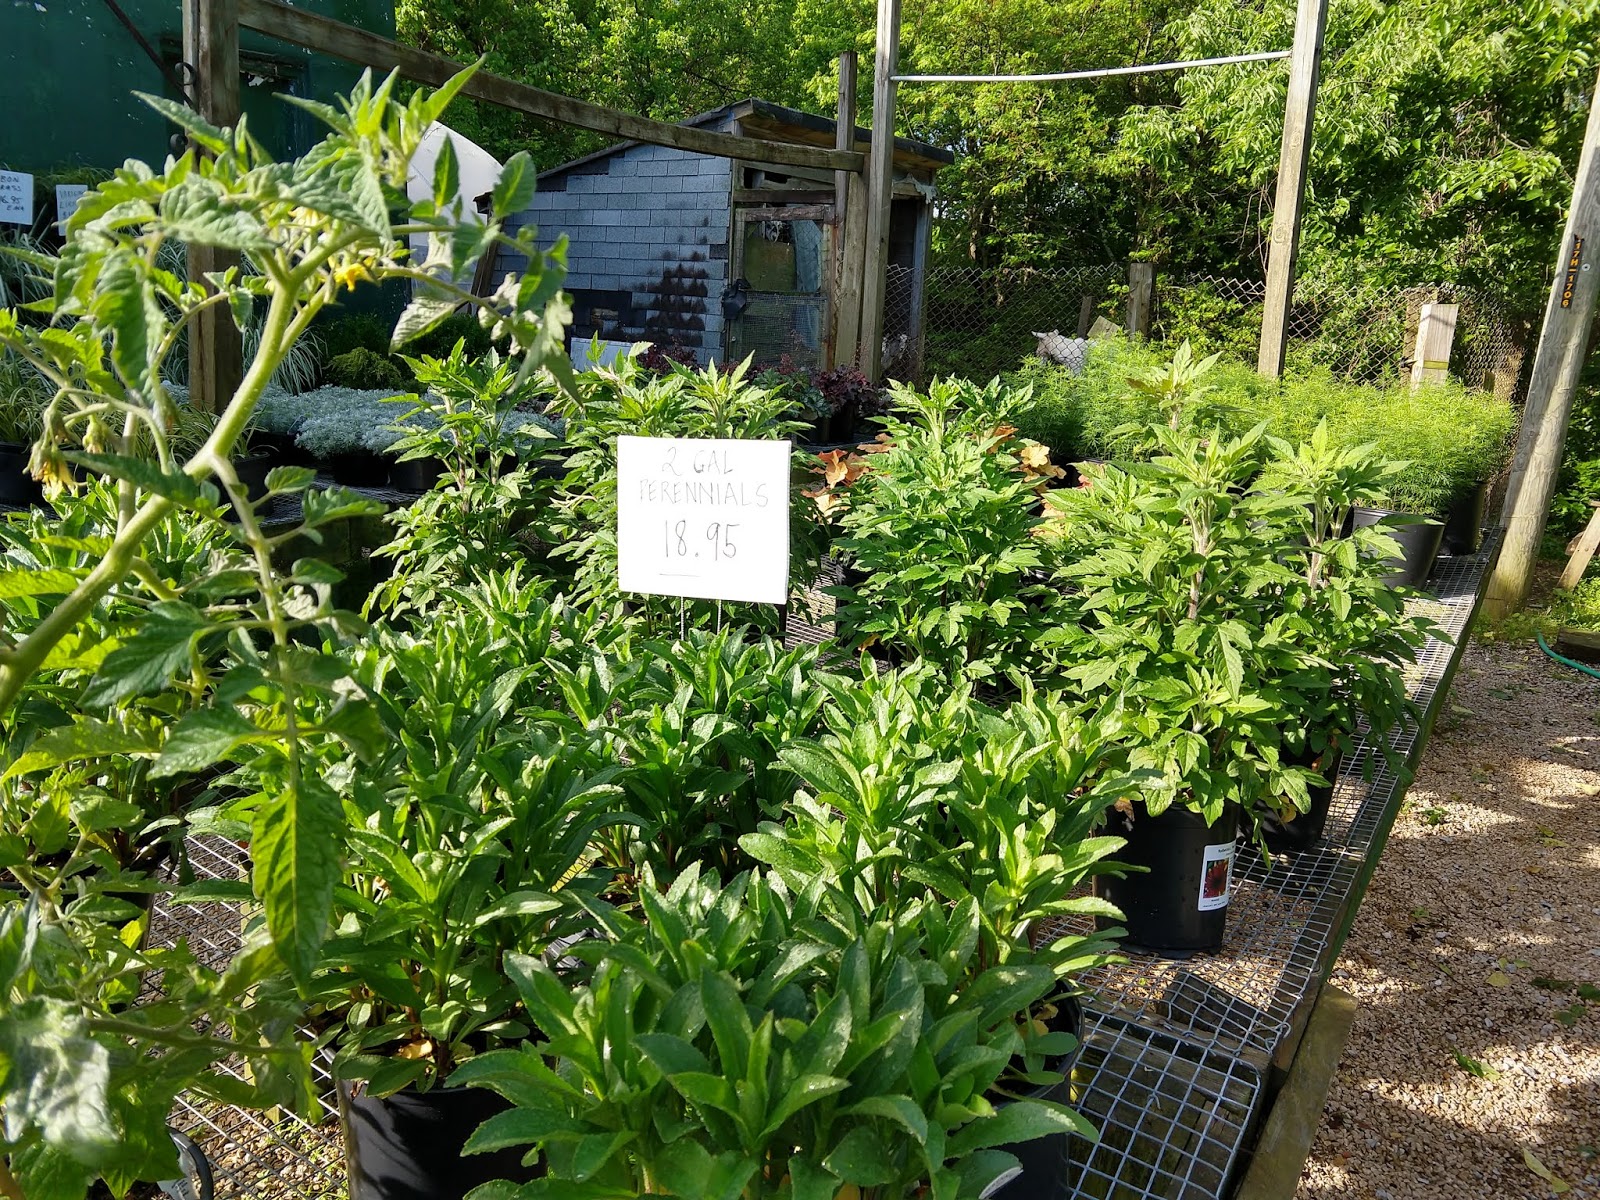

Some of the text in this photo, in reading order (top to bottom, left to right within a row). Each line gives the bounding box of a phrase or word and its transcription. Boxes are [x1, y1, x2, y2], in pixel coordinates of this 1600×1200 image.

[661, 446, 733, 477] 2 GAL
[639, 478, 769, 508] PERENNIALS
[665, 519, 741, 561] 18.95
